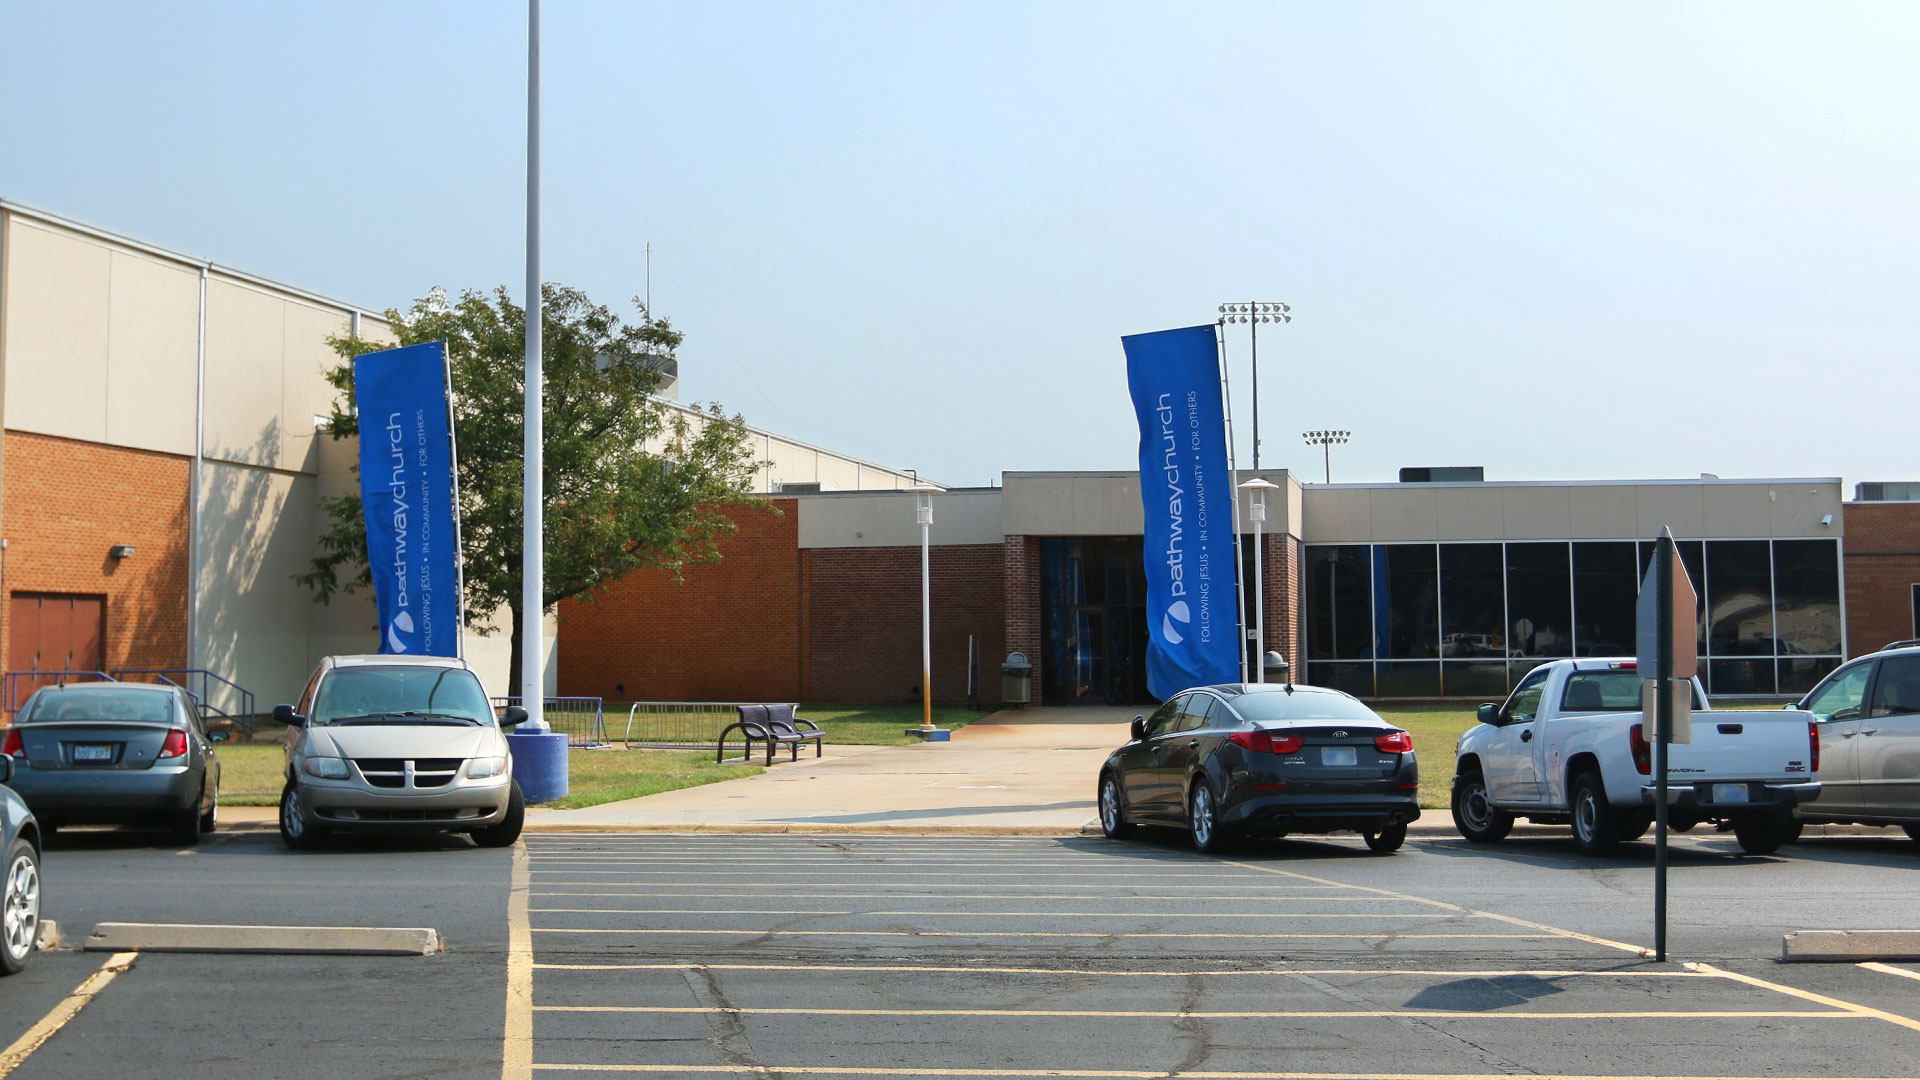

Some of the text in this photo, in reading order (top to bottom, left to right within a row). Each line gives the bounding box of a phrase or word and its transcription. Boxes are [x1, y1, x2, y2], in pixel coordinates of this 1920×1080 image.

[386, 411, 410, 607] pathwaychurch
[416, 409, 432, 653] FOLLOWING JESUS IN COMMUNITY FOR OTHERS
[1156, 392, 1187, 598] pathwaychurch
[1187, 390, 1211, 643] FOLLOWING JESUS IN COMMUNITY FOR OTHERS
